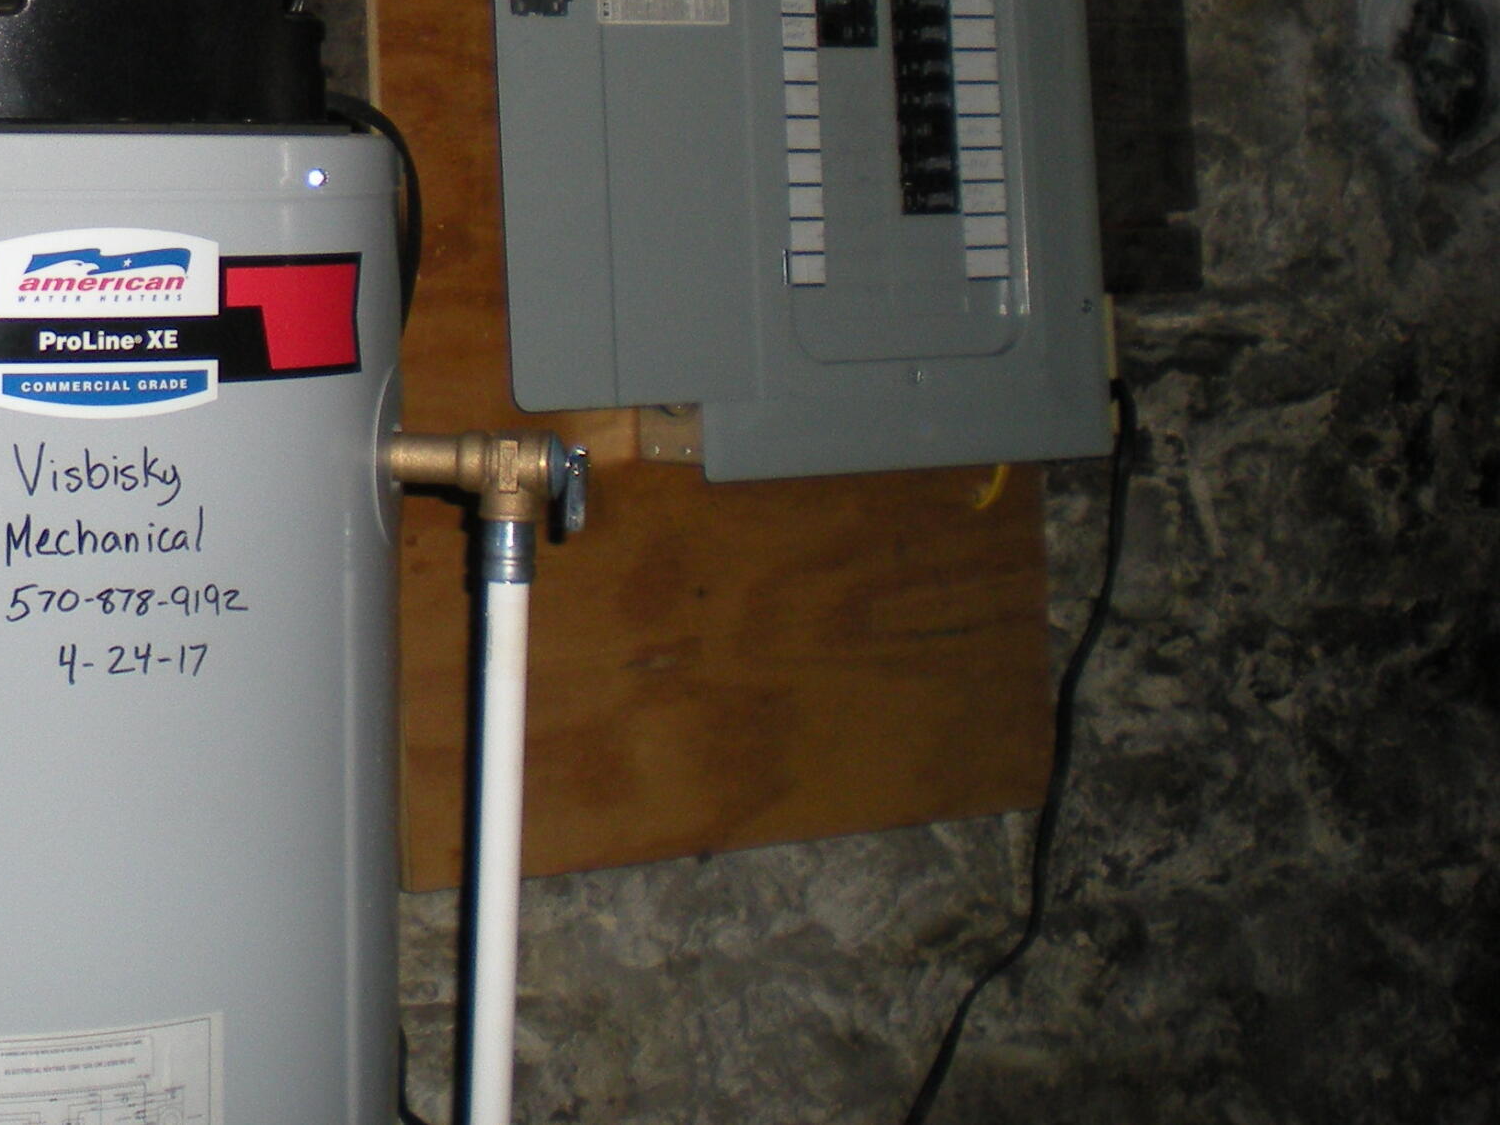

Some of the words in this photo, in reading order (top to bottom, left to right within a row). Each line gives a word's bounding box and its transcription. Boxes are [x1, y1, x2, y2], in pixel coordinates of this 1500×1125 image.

[17, 275, 186, 293] american
[17, 294, 82, 304] WATER
[99, 293, 183, 303] HEATERS
[146, 329, 179, 350] XE
[20, 379, 131, 393] COMMERCIAL
[137, 378, 189, 391] GRADE
[12, 441, 182, 507] Visbisky
[5, 505, 204, 568] Mechanical
[5, 583, 249, 623] 570-878-9192
